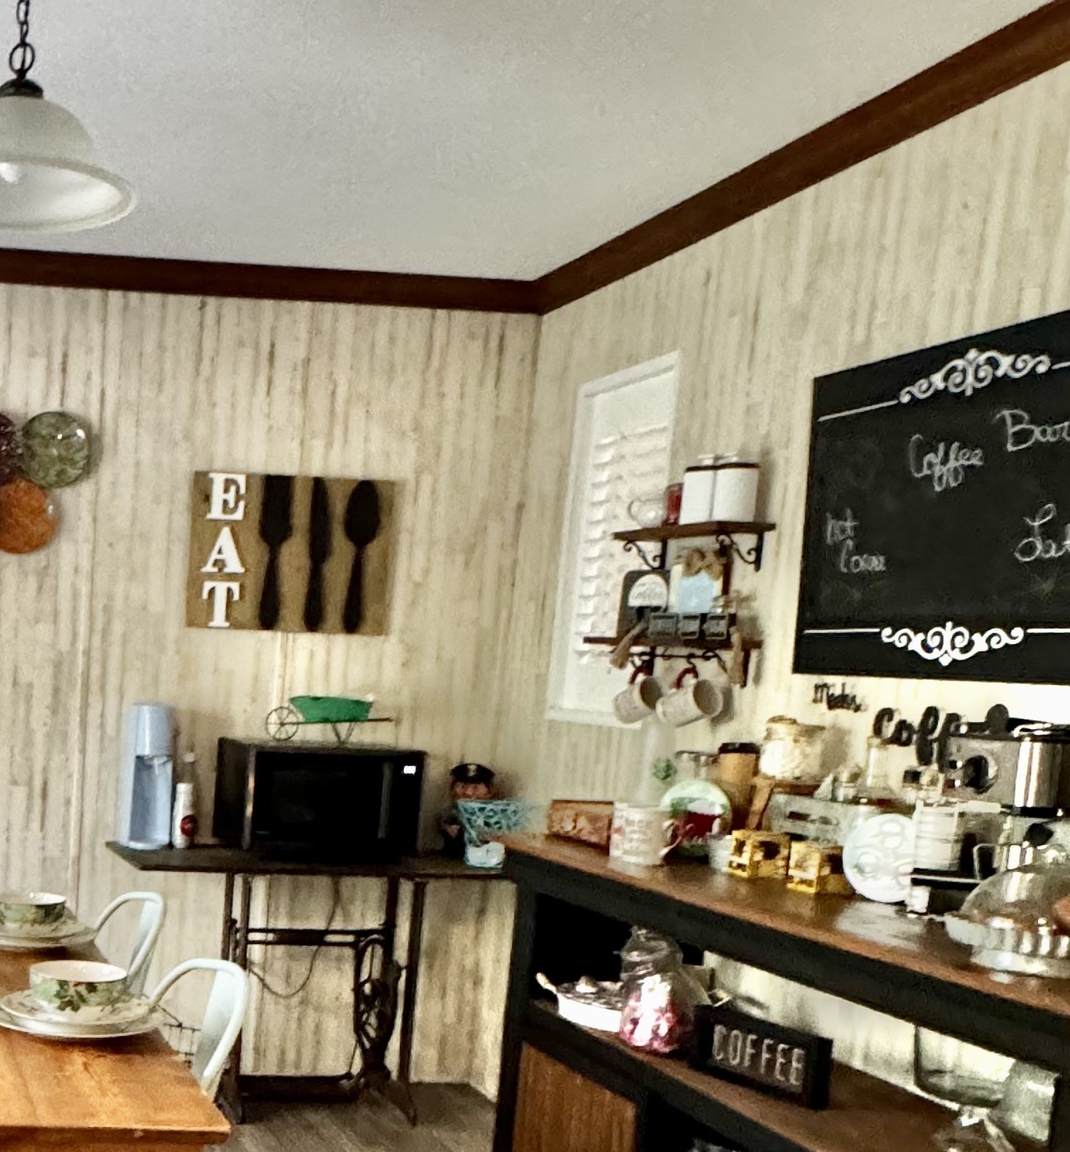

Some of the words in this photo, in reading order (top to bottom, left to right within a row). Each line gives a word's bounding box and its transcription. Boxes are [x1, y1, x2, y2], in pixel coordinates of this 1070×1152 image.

[909, 433, 984, 491] Coffee
[991, 409, 1070, 451] Bar
[200, 472, 246, 628] EAT
[712, 1024, 805, 1086] COFFEE
